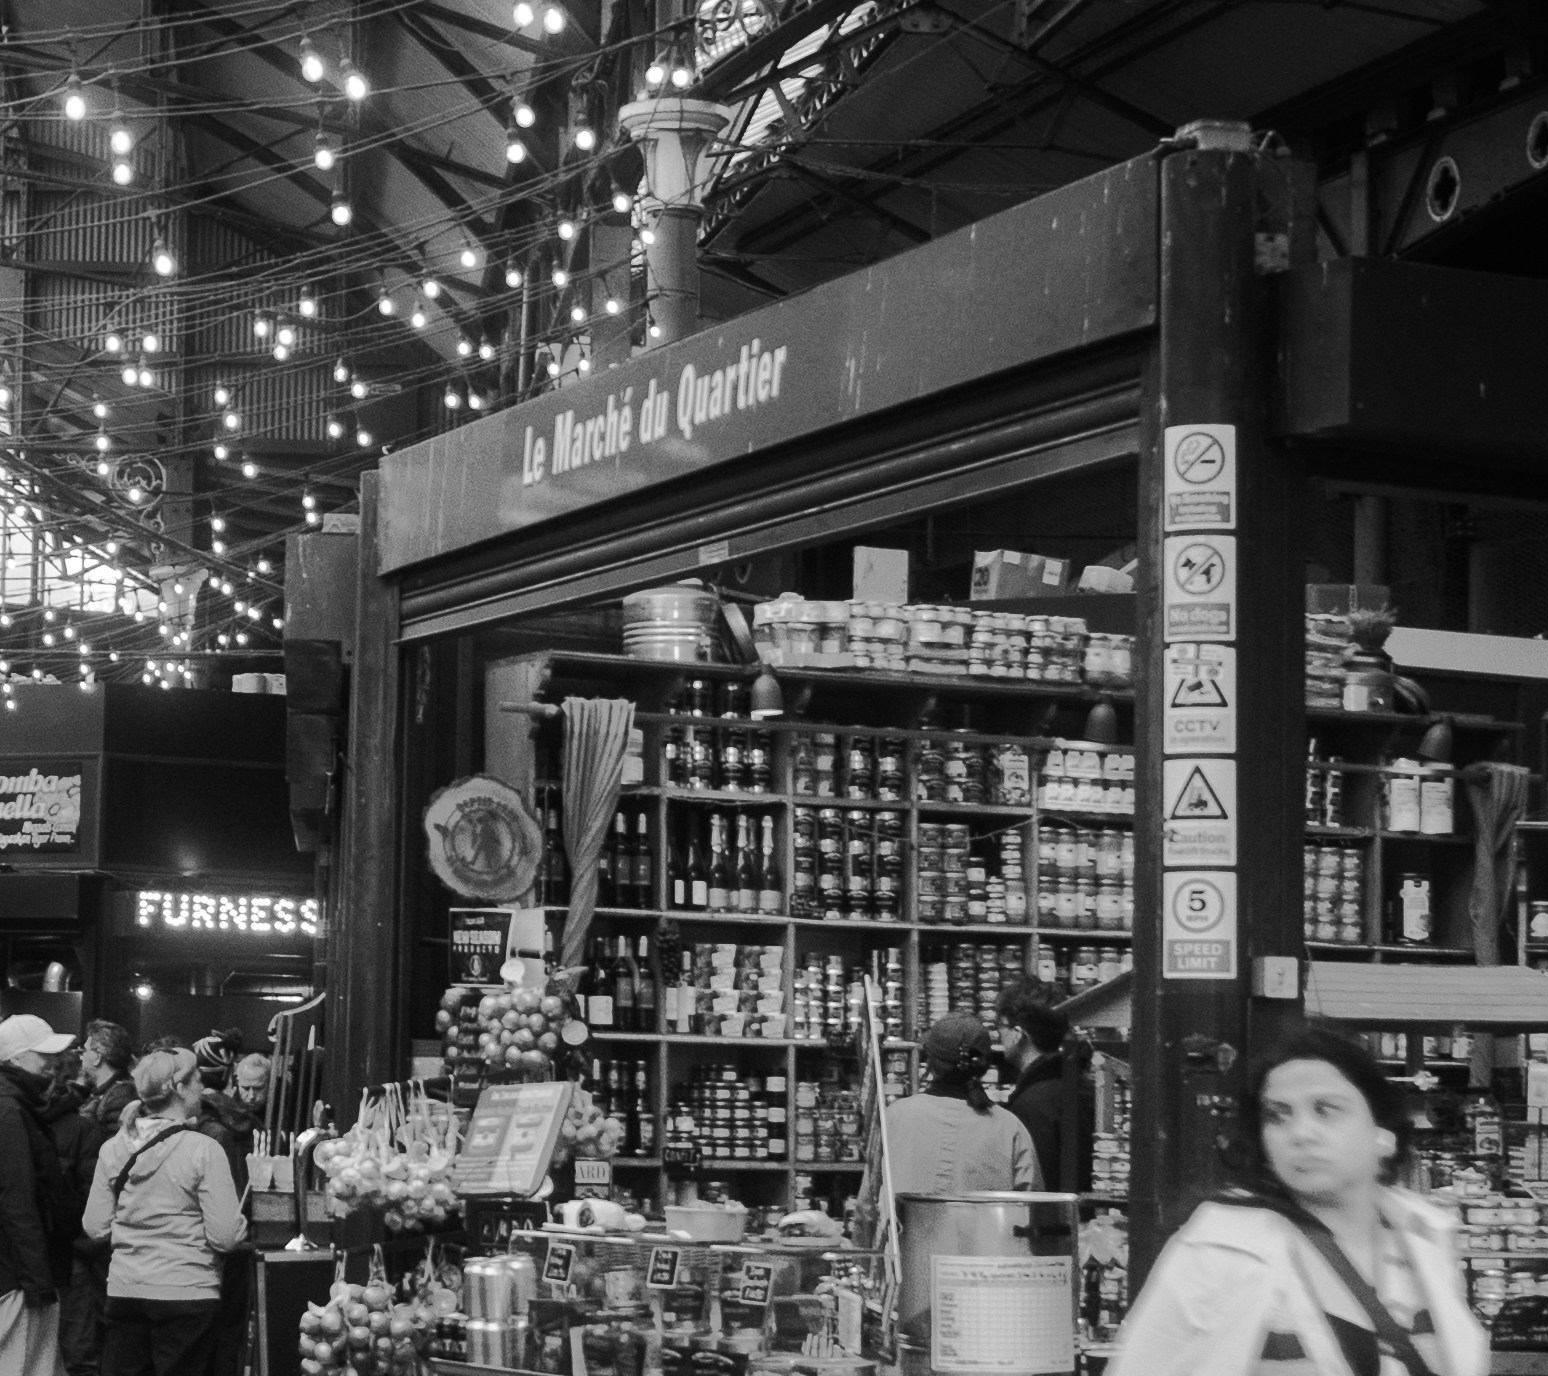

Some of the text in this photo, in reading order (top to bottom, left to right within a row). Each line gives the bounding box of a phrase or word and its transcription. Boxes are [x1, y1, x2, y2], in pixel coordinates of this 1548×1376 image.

[523, 338, 787, 485] Le Marché du Quartier
[1174, 719, 1220, 733] CCTV
[1188, 890, 1207, 911] 5
[138, 891, 320, 935] FURNESS
[1173, 943, 1223, 955] SPEED
[1176, 957, 1218, 969] LIMIT
